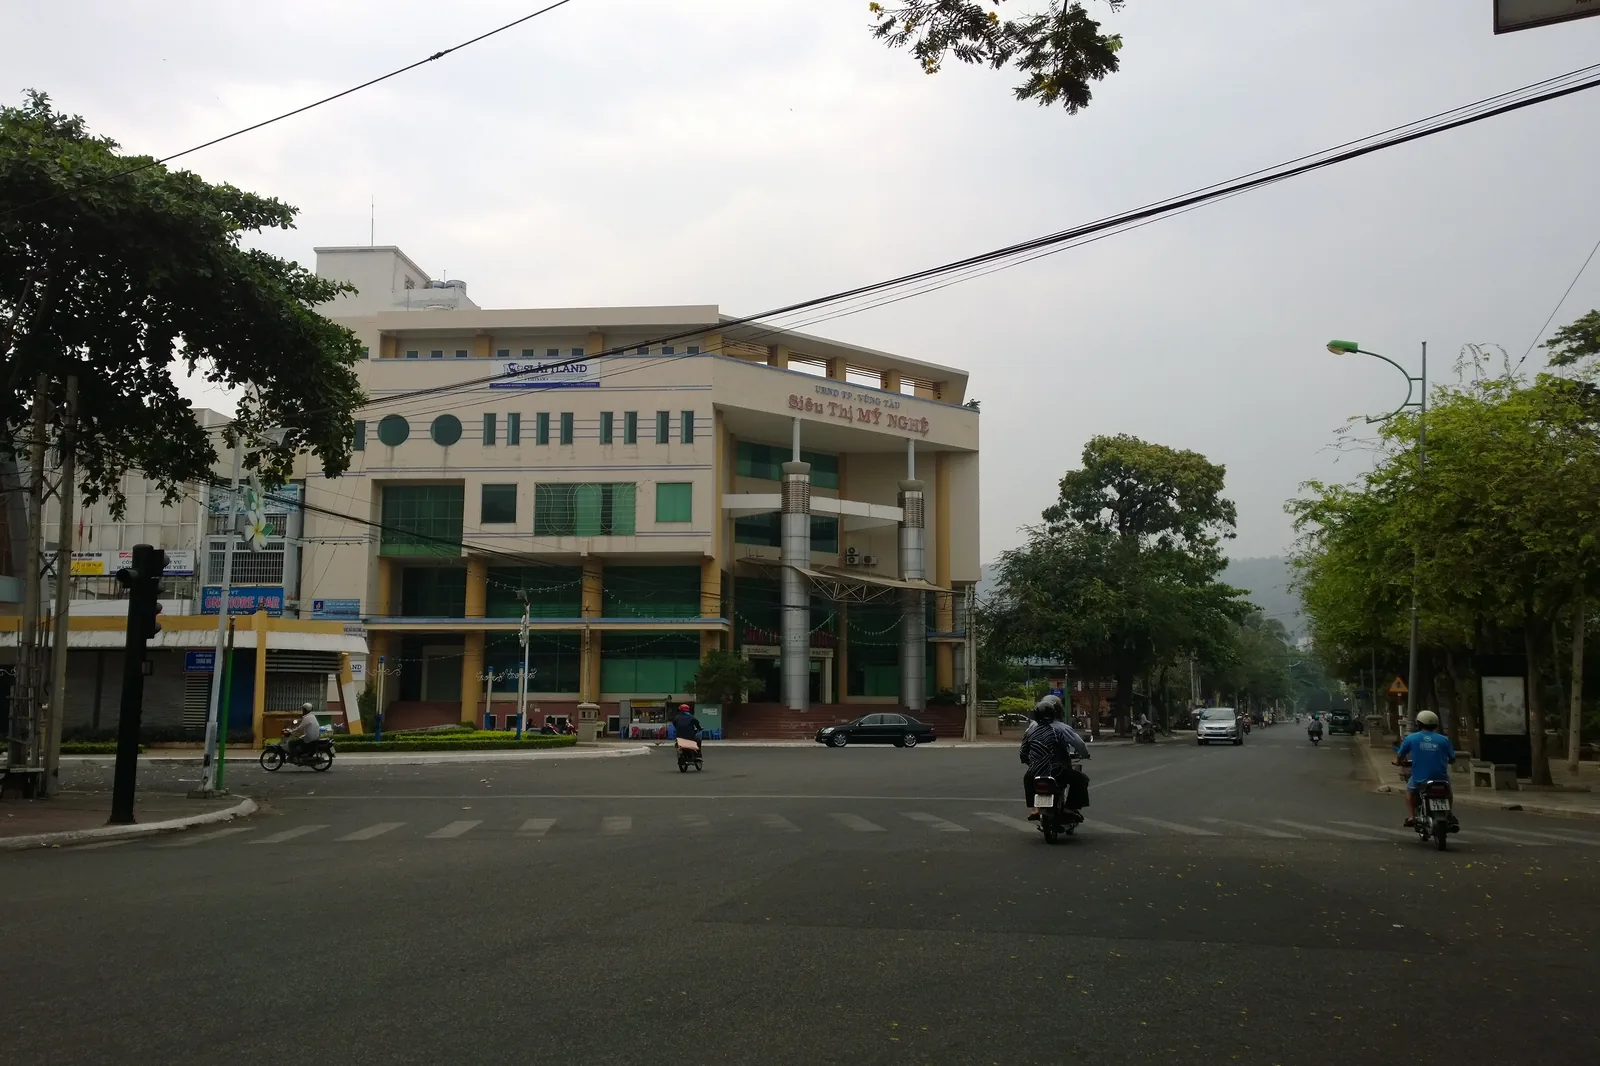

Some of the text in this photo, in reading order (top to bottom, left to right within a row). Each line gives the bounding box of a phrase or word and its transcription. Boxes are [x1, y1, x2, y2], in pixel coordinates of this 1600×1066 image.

[815, 385, 839, 398] UBND
[788, 394, 824, 415] Siêu
[827, 401, 854, 424] Thị
